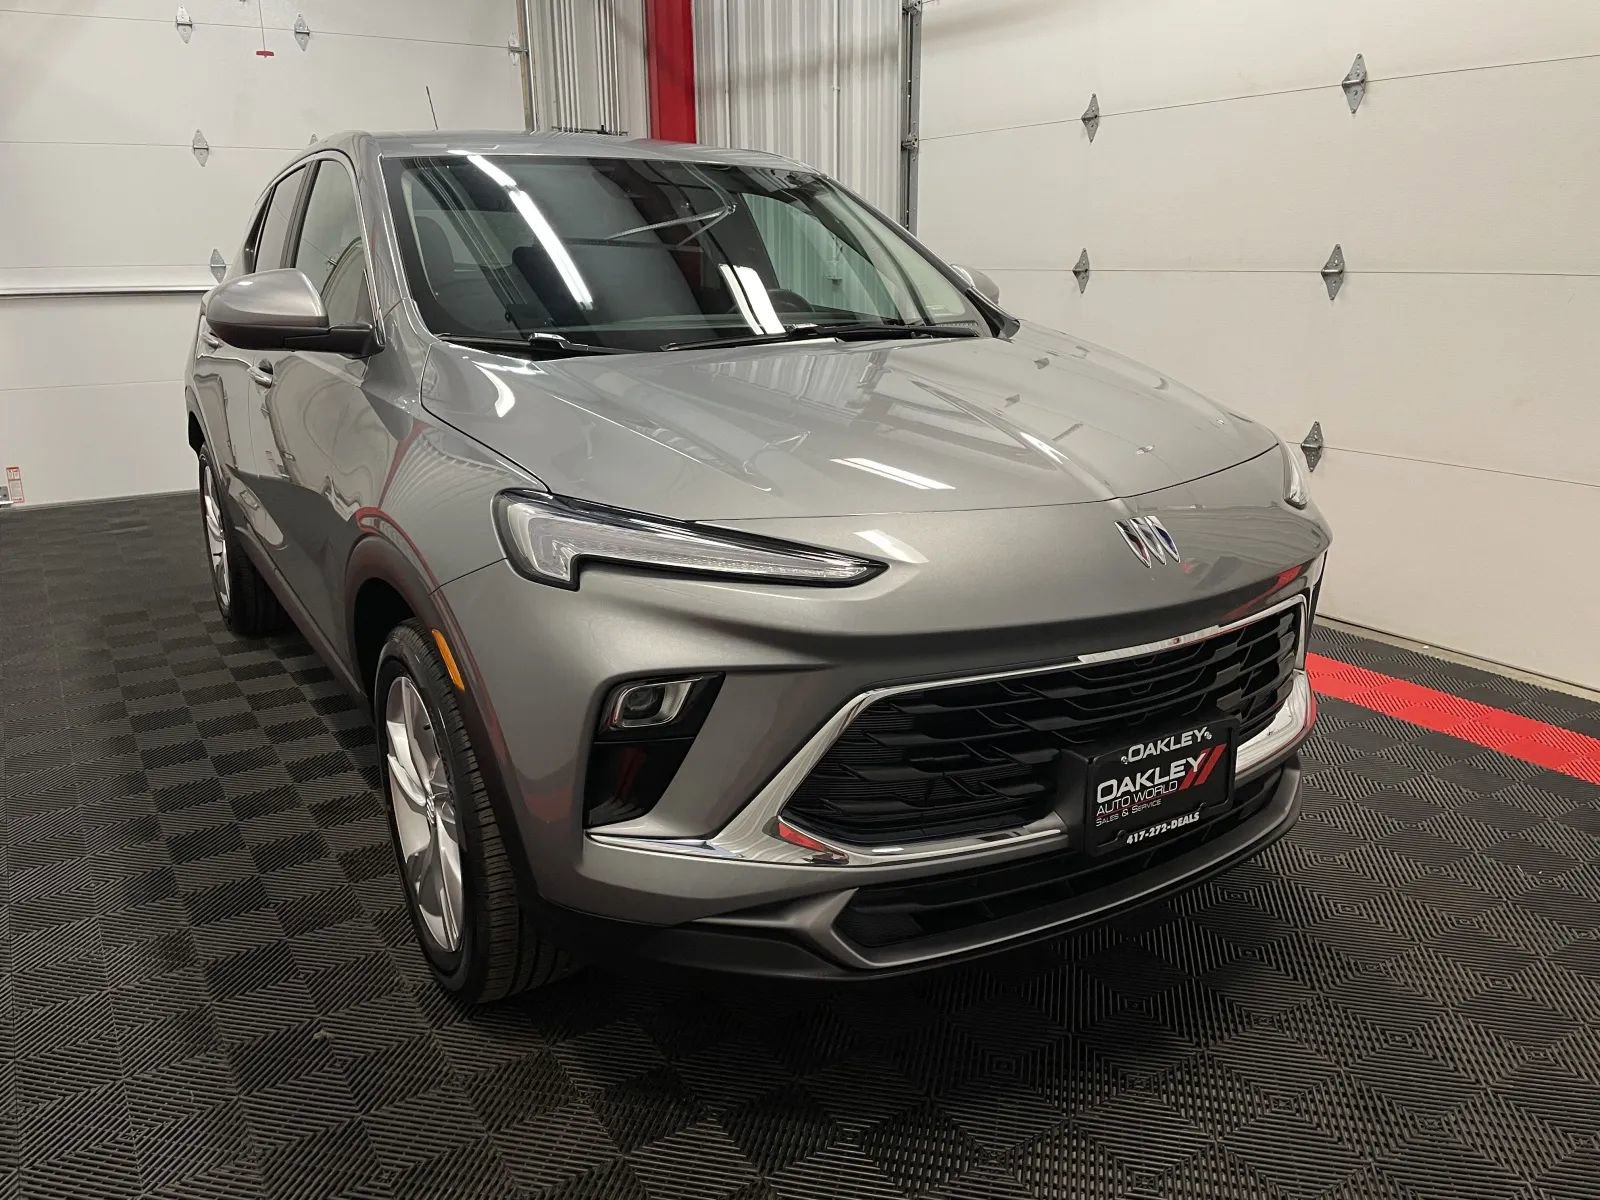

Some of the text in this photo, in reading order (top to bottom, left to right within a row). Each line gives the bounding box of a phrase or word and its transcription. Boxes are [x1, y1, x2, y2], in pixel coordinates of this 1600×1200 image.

[1127, 726, 1208, 763] OAKLEY
[1096, 752, 1207, 804] OAKLEY
[1096, 780, 1178, 817] AUTO WORLD
[1121, 808, 1129, 817] &
[1126, 811, 1200, 845] 417-272-DEALS
